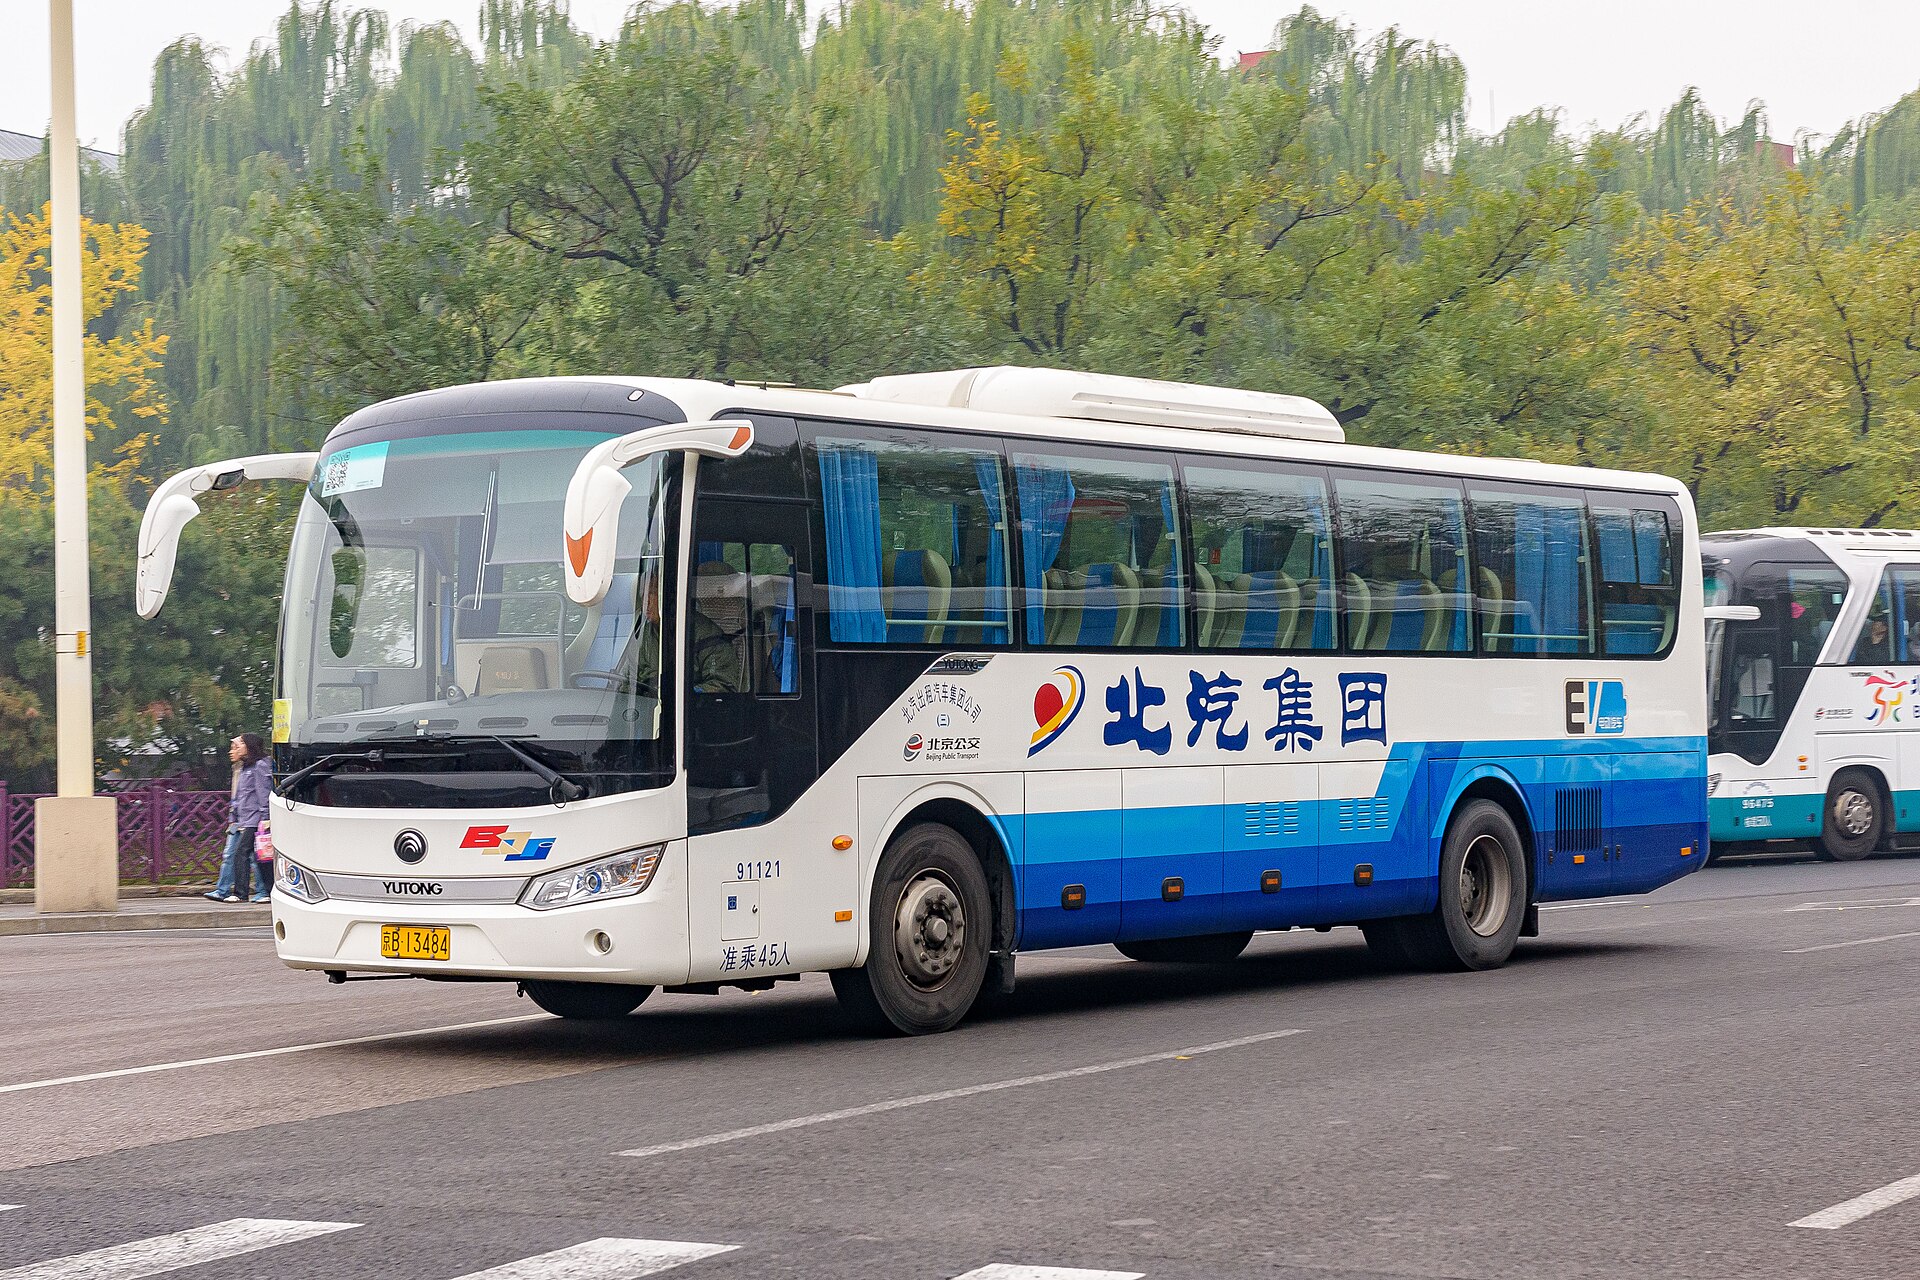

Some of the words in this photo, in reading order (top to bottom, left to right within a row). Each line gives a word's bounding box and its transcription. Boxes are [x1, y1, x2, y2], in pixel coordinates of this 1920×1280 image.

[942, 659, 979, 671] YUTONG
[901, 682, 982, 724] 北汽出租汽车集团公司
[1103, 666, 1388, 756] 北汽集团
[926, 737, 981, 751] 北京公交
[925, 753, 942, 762] Beijing
[942, 752, 956, 760] Public
[956, 752, 979, 760] Transport
[737, 860, 780, 880] 91121
[382, 881, 443, 895] YUTONG
[719, 941, 791, 972] 准乘45人
